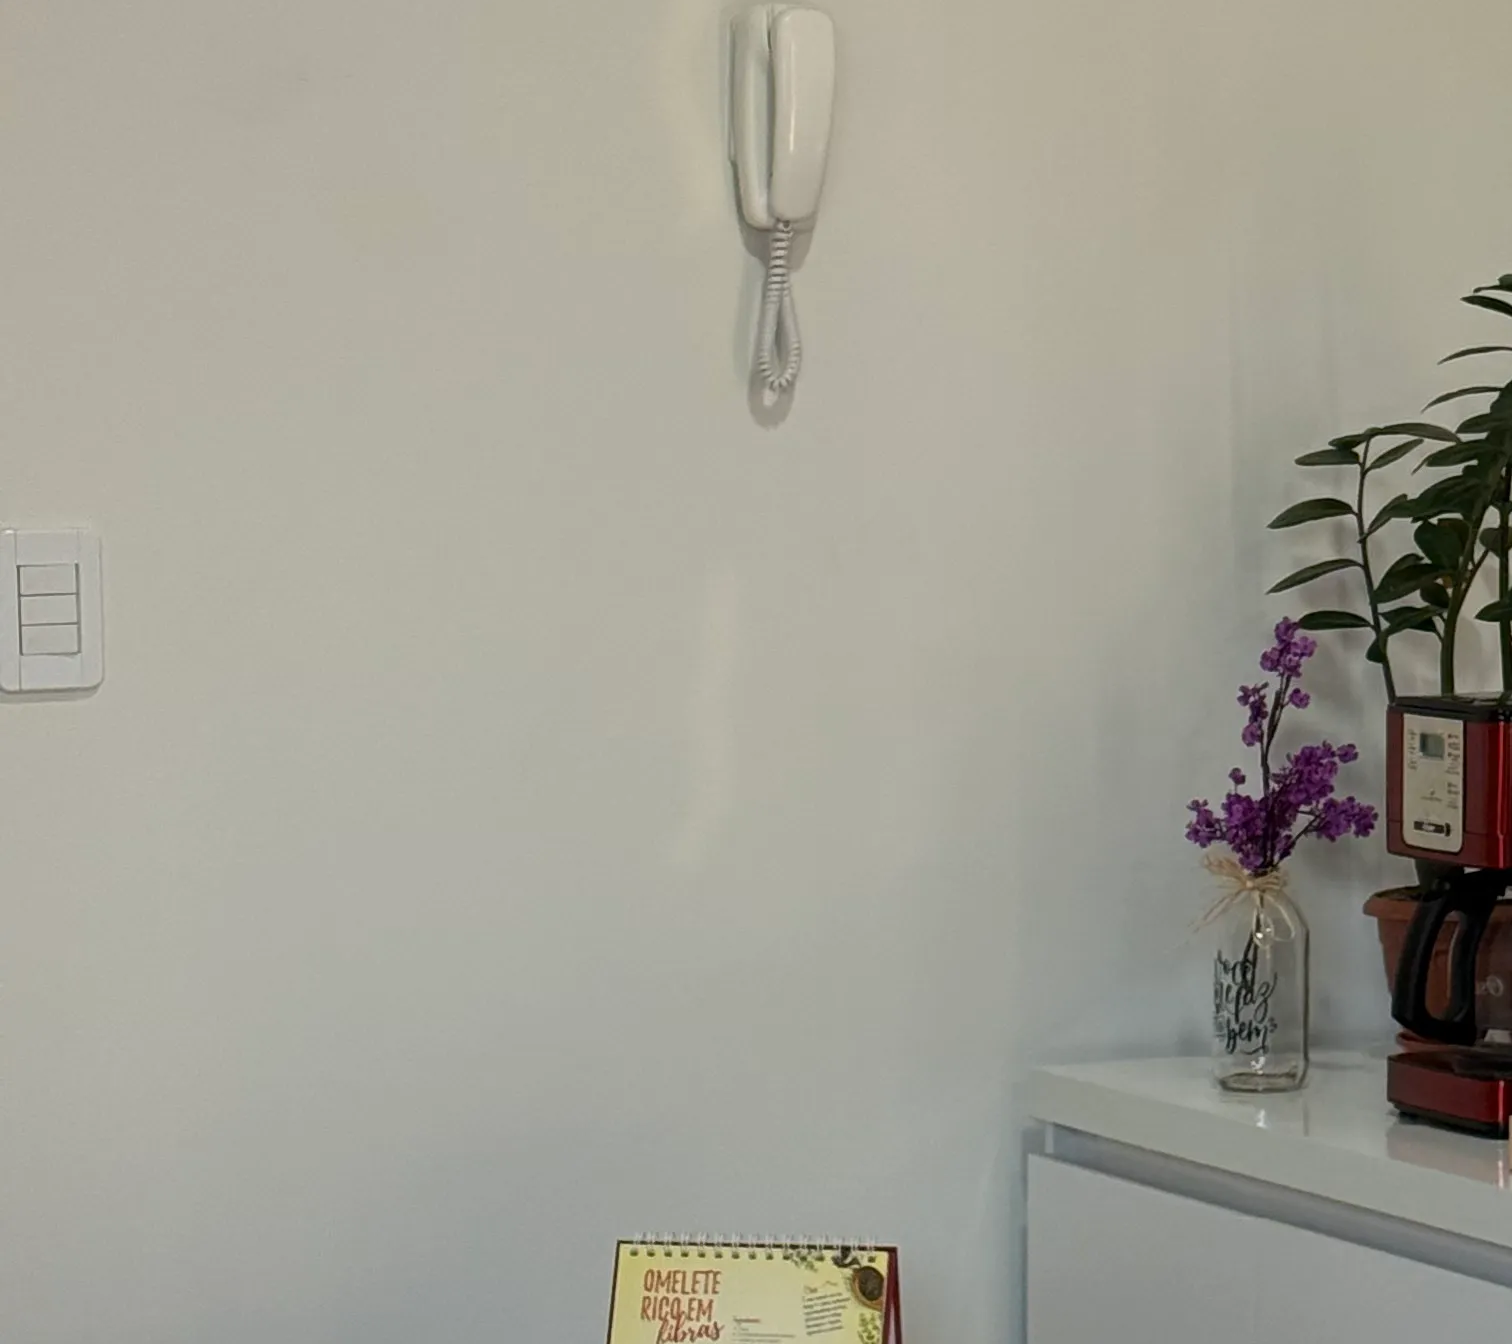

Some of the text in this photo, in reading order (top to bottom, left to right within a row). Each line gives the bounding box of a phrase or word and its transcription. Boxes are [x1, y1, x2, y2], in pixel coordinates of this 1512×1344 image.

[644, 1268, 722, 1295] OMELETE
[641, 1295, 714, 1322] RICO EM
